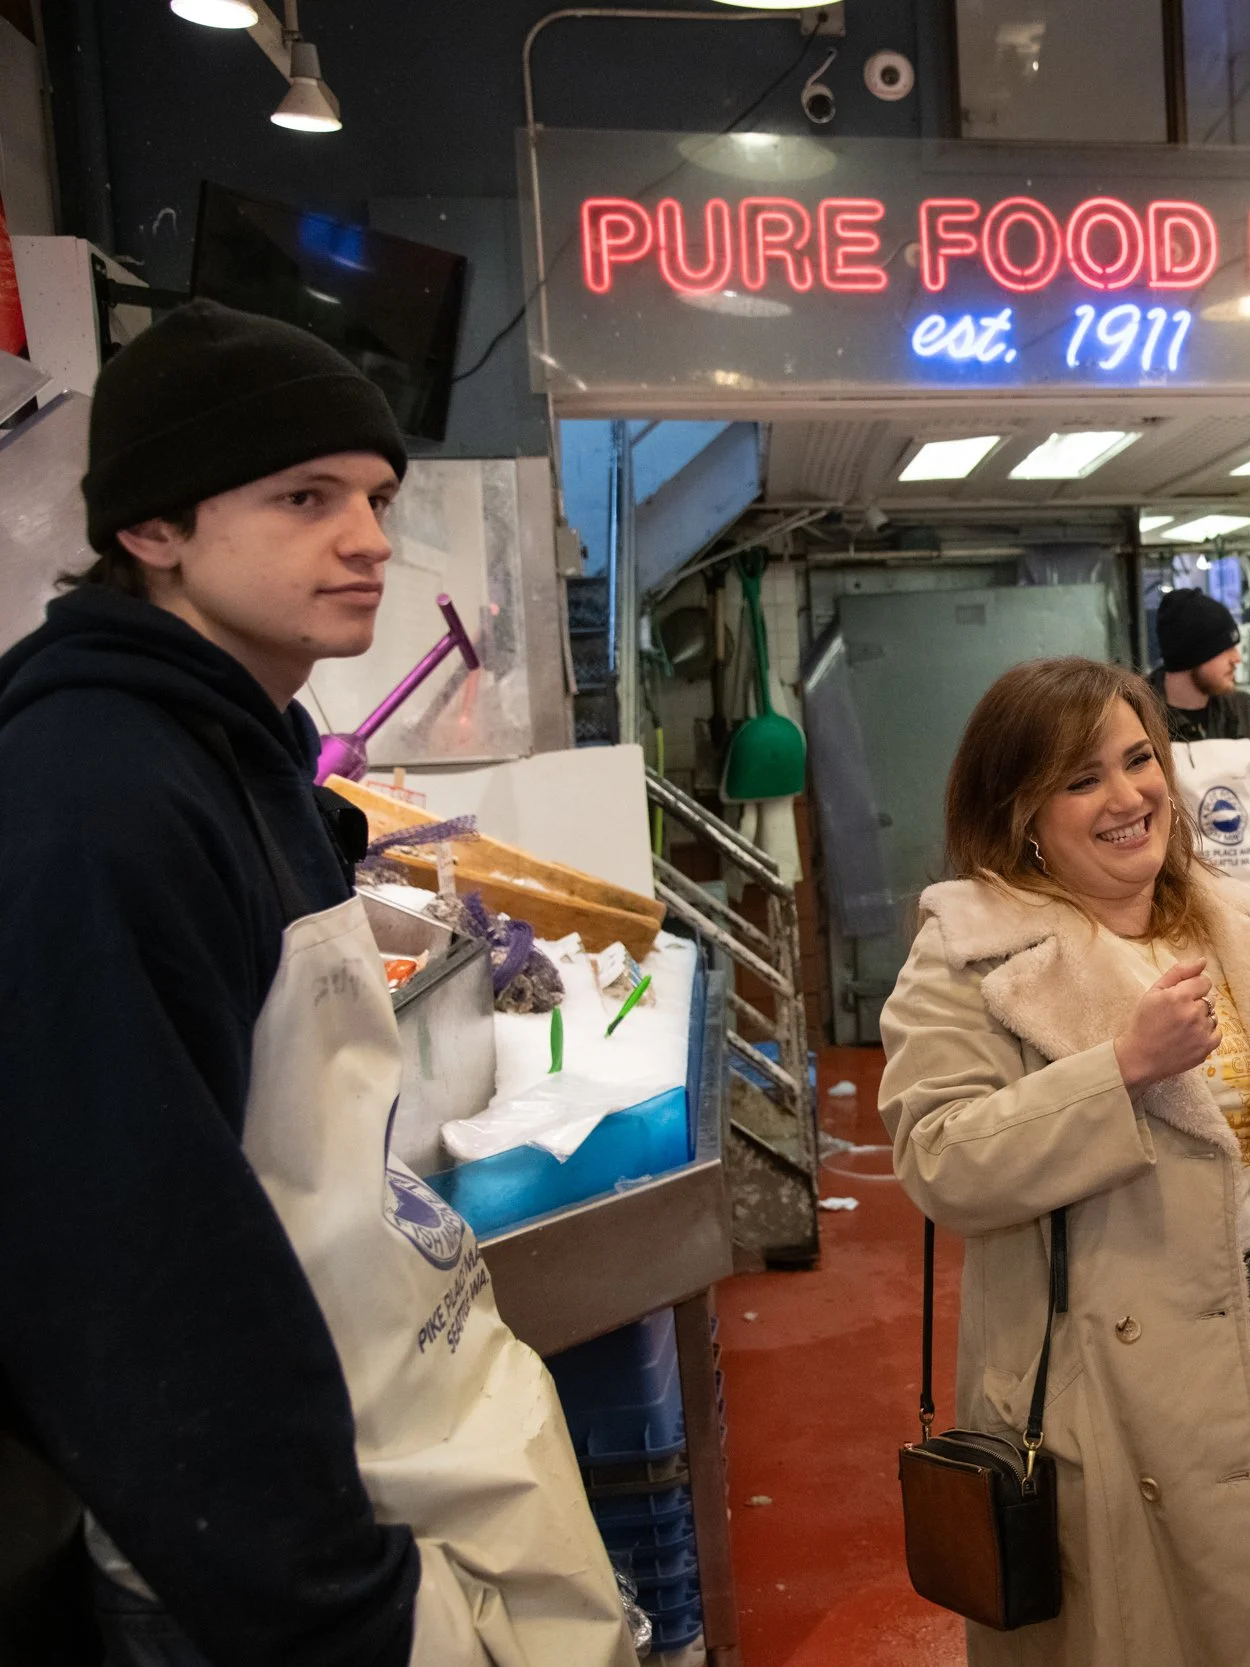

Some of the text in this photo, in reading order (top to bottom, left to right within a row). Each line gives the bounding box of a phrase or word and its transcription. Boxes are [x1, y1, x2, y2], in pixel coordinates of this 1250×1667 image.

[582, 197, 889, 295] PURE
[919, 196, 1217, 292] FOOD
[911, 303, 1193, 372] est. 1911
[417, 1303, 447, 1355] PIKE
